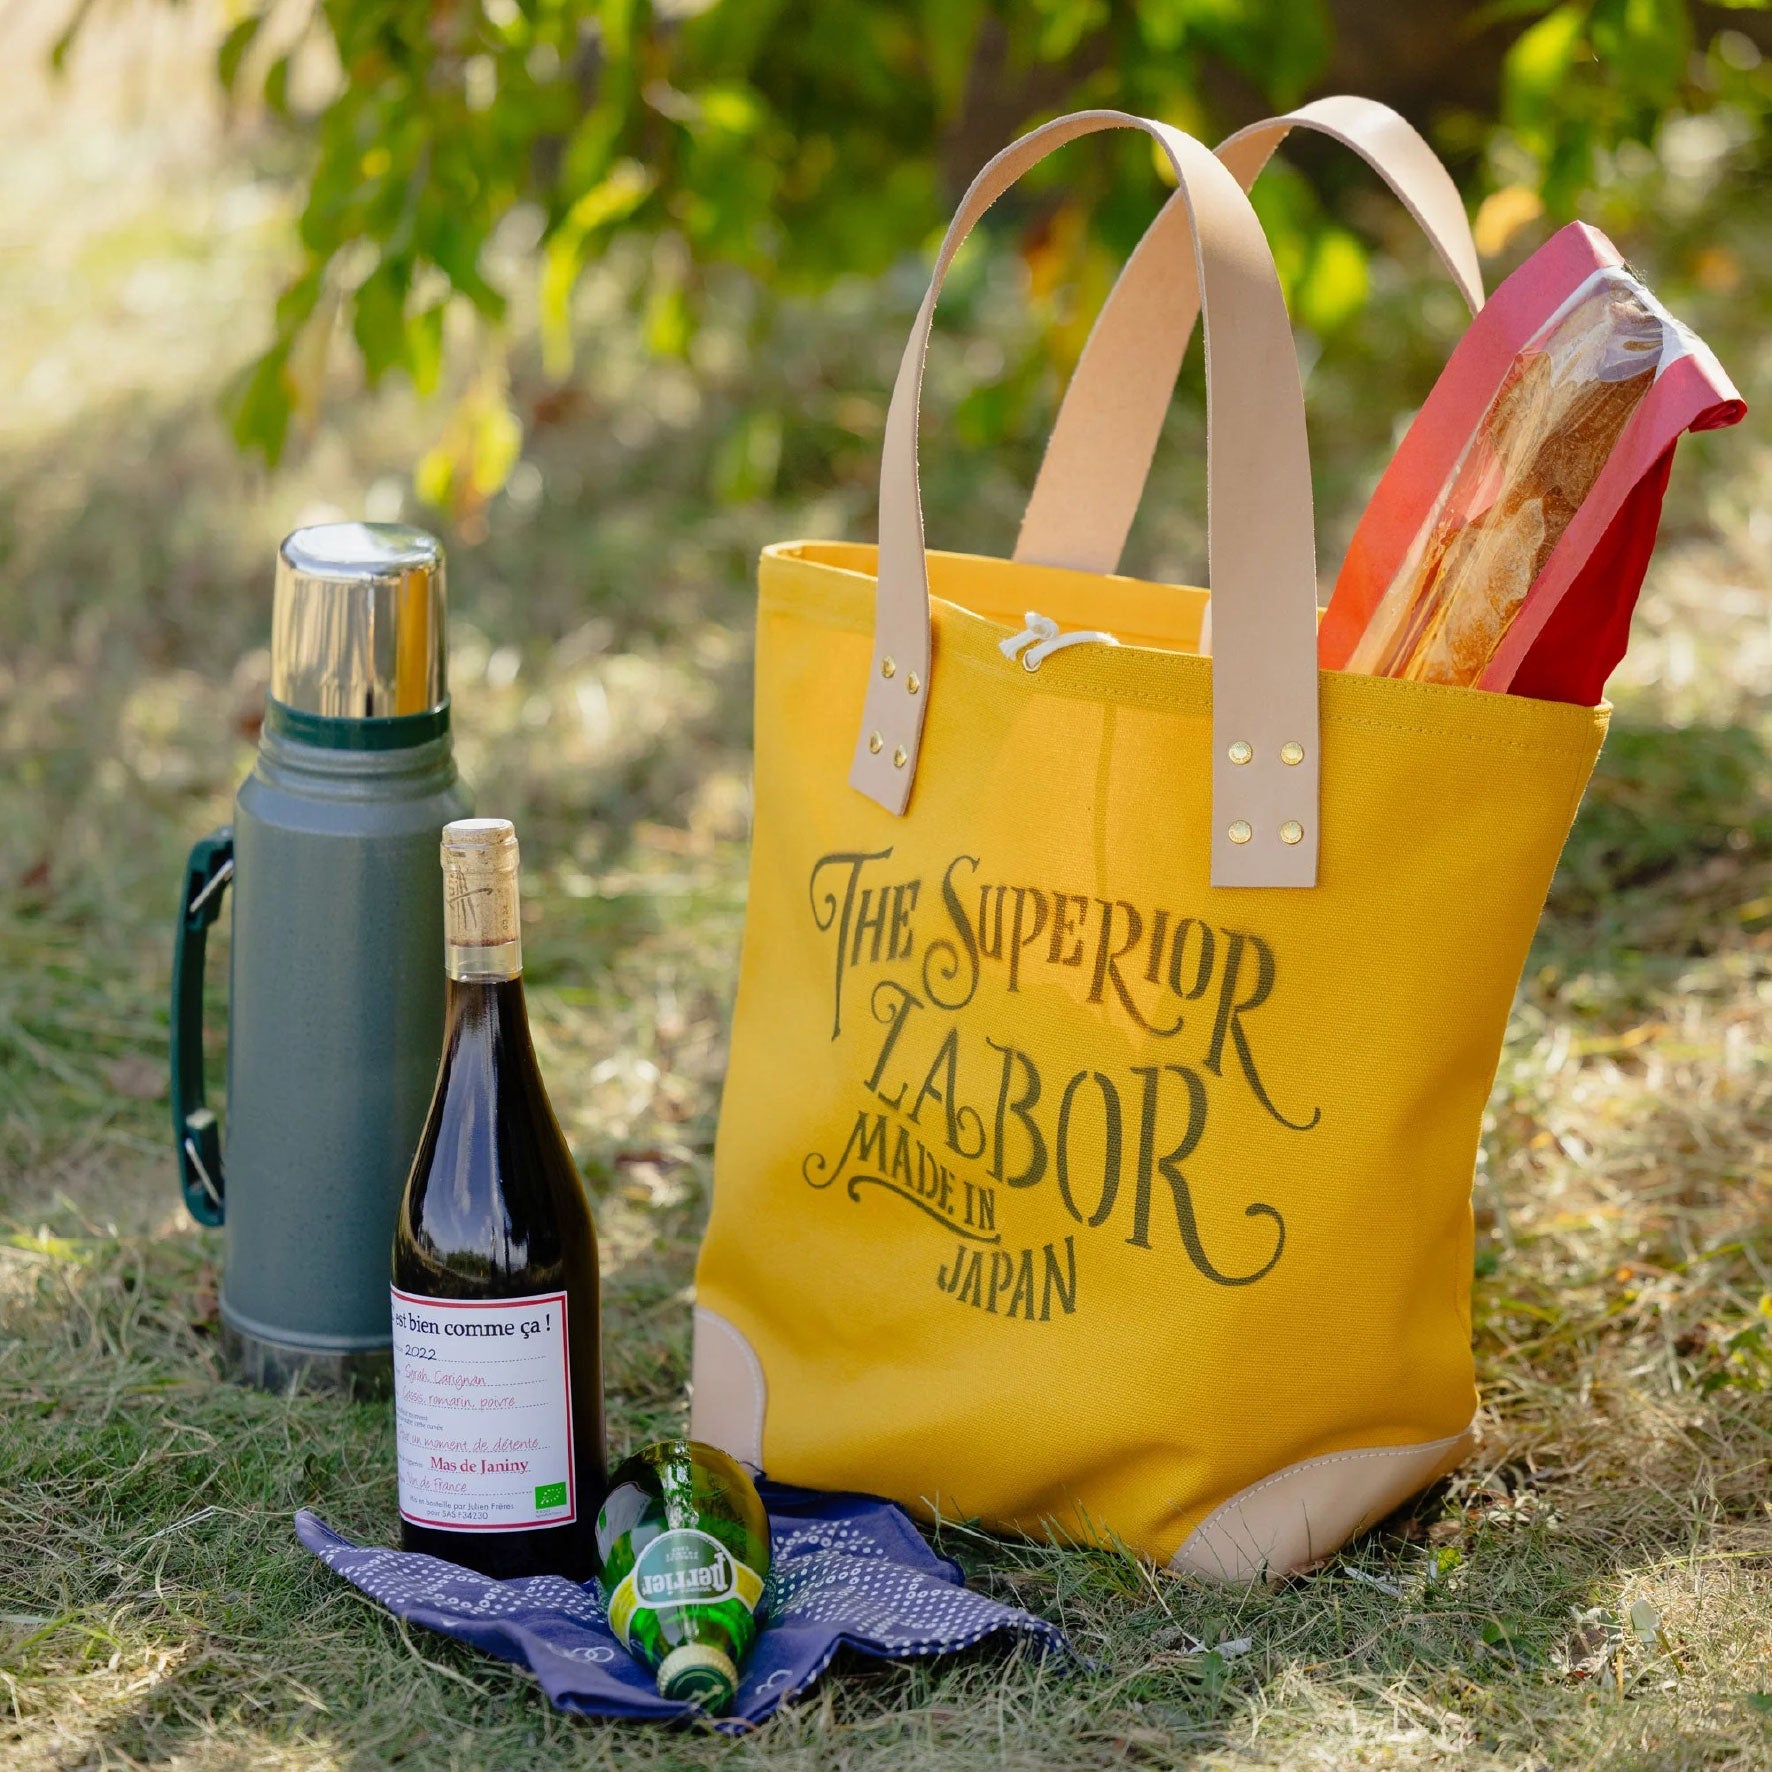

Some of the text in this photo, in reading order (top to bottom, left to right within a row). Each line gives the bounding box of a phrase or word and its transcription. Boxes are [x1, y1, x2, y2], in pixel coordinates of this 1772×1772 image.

[921, 855, 1322, 1132] SUPERIOR
[863, 980, 1286, 1287] LABOR
[963, 1184, 997, 1231] IN
[936, 1236, 1077, 1322] JAPAN
[408, 1312, 440, 1335] bien
[444, 1320, 515, 1337] comme
[520, 1320, 541, 1339] ça
[404, 1344, 438, 1361] 2022
[434, 1369, 487, 1390] Carignan
[480, 1396, 516, 1411] poivre
[424, 1438, 468, 1451] moment
[473, 1437, 488, 1451] de
[430, 1456, 457, 1471] Mas
[460, 1457, 477, 1472] de
[480, 1458, 529, 1475] Janiny
[434, 1477, 467, 1492] France
[442, 1510, 456, 1519] SAS
[453, 1503, 466, 1511] par
[467, 1501, 489, 1511] Julien
